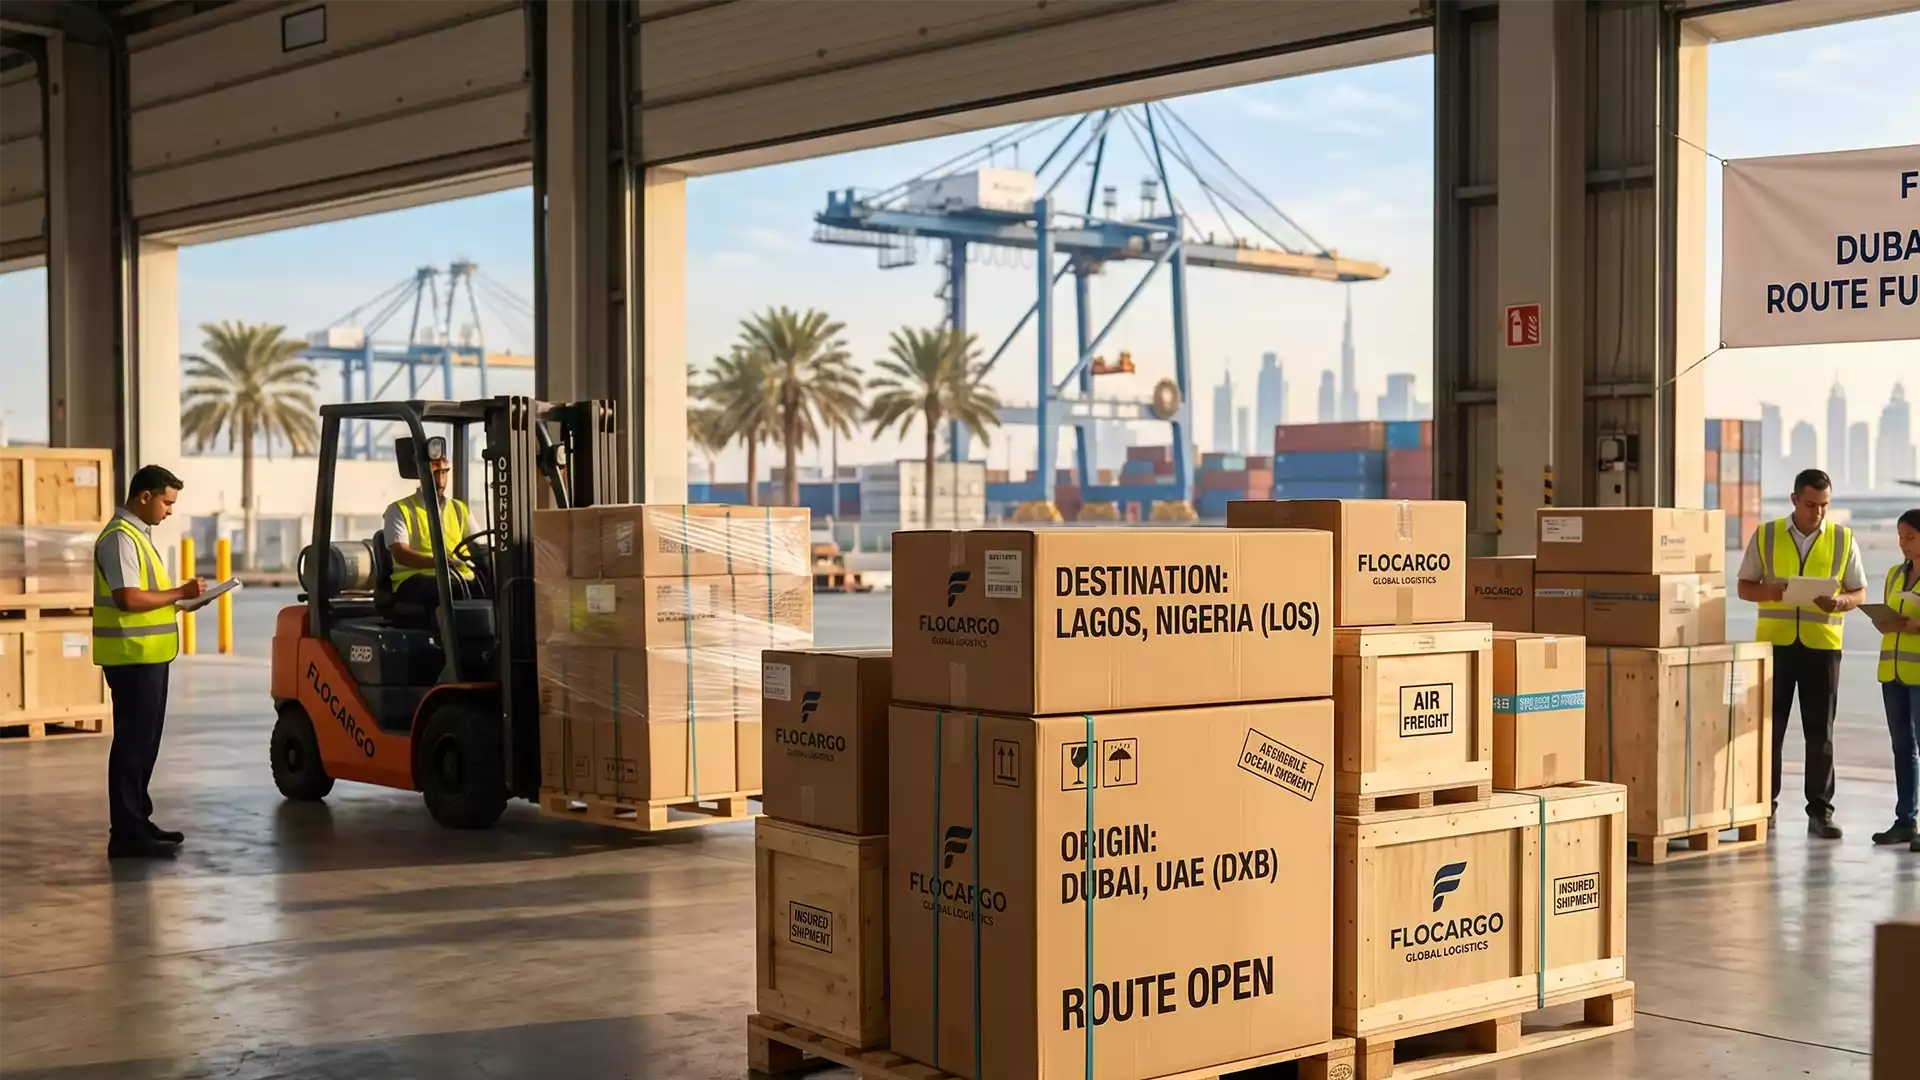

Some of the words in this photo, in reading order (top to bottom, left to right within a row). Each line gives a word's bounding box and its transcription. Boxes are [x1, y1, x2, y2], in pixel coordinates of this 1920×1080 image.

[1837, 229, 1920, 265] DUBA
[1767, 278, 1868, 314] ROUTE
[1358, 553, 1451, 572] FLOCARGO
[1056, 565, 1228, 596] DESTINATION:
[1372, 577, 1400, 585] GLOBAL
[1401, 576, 1437, 585] LOGISTICS
[1474, 586, 1523, 596] FLOCARGO
[919, 615, 999, 635] FLOCARGO
[1056, 606, 1148, 641] LAGOS,
[1156, 604, 1253, 635] NIGERIA
[1261, 601, 1320, 638] (LOS)
[306, 661, 375, 758] FLOCARGO
[1413, 690, 1440, 711] AIR
[1403, 713, 1449, 731] FREIGHT
[776, 728, 845, 752] FLOCARGO
[1244, 752, 1274, 775] OCEAN
[1061, 823, 1156, 862] ORIGIN:
[1062, 865, 1148, 904] DUBAI,
[1156, 857, 1204, 891] UAE
[1213, 847, 1278, 891] (DXB)
[1559, 878, 1595, 895] INSURED
[1556, 892, 1598, 909] SHIPMENT
[795, 909, 829, 929] INSURED
[1391, 912, 1504, 950] FLOCARGO
[1405, 948, 1442, 963] GLOBAL
[1443, 940, 1488, 957] LOGISTICS
[1062, 972, 1176, 1031] ROUTE
[1188, 956, 1273, 1008] OPEN
